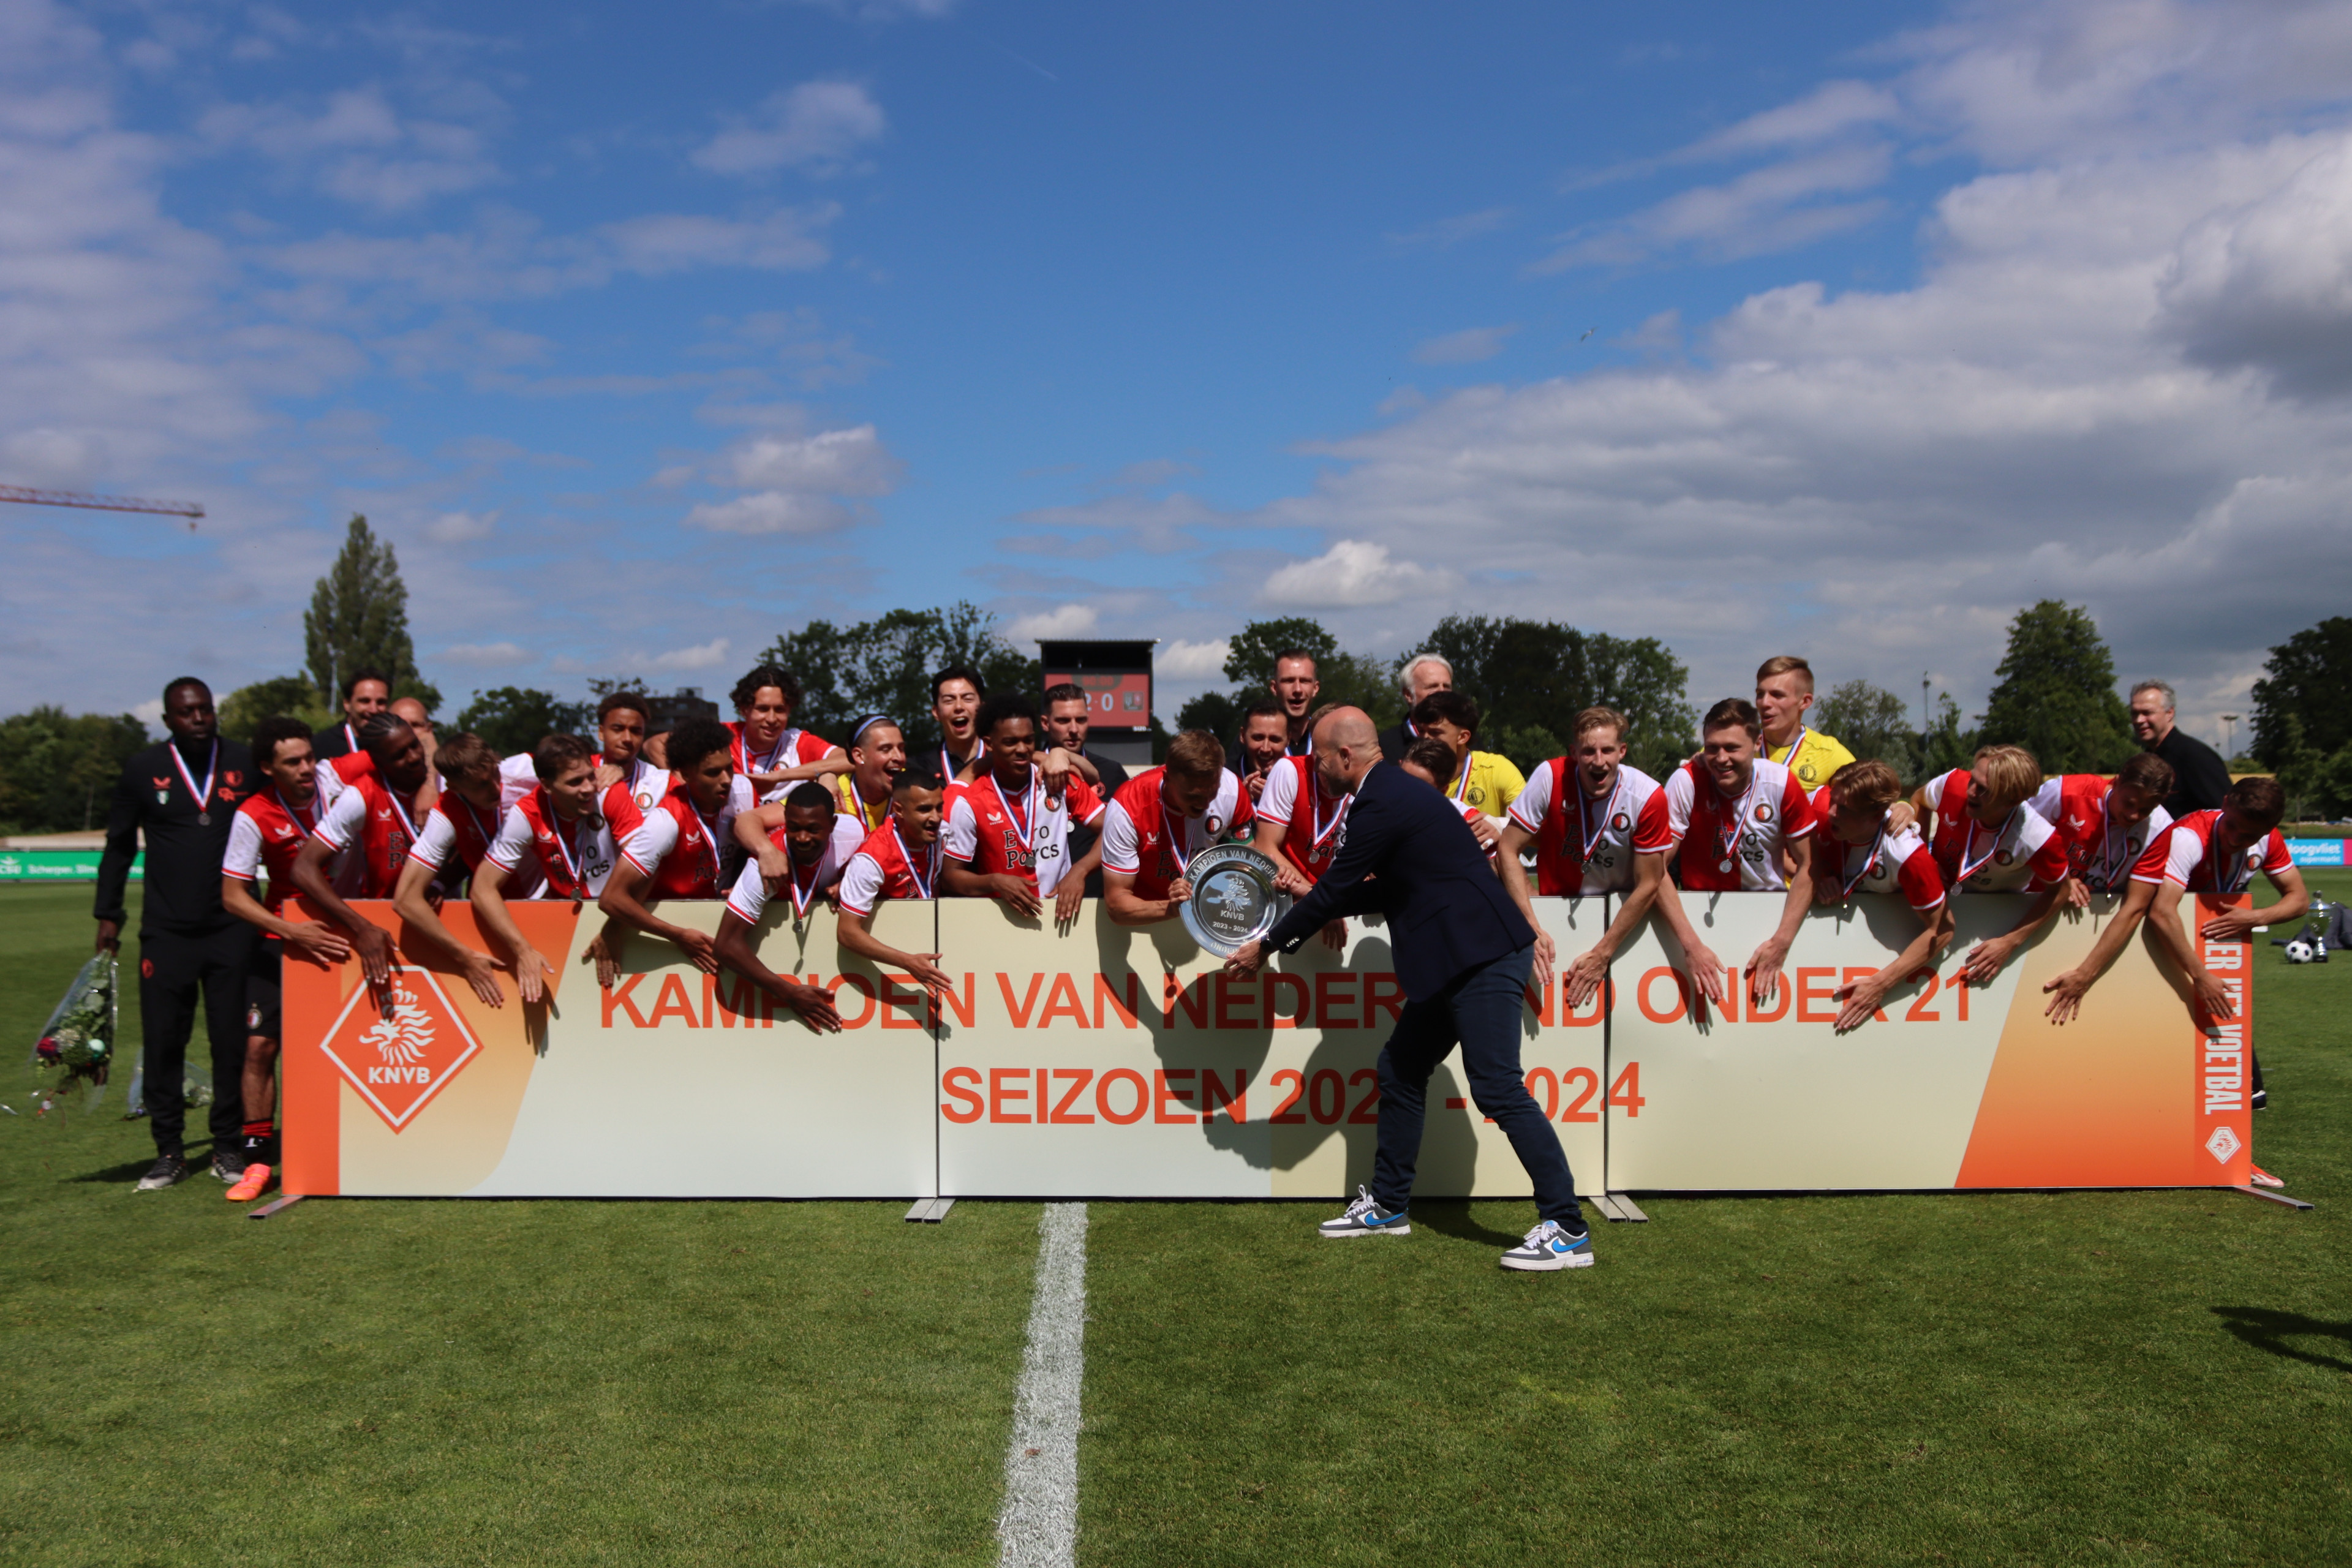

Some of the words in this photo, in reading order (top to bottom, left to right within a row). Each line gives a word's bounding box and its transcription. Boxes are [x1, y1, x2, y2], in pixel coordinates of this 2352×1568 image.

[1101, 693, 1114, 711] 0
[1003, 826, 1049, 850] Ero
[1564, 824, 1609, 850] Eo
[1189, 851, 1227, 881] KAMPIOEN
[1230, 850, 1246, 859] VAN
[1560, 843, 1614, 868] Pacs
[1711, 845, 1765, 863] Pcs
[554, 859, 610, 885] Prcs
[1213, 921, 1228, 930] 2023
[1220, 910, 1245, 921] KNVB
[2205, 933, 2243, 970] IER
[995, 972, 1138, 1029] VAN
[1163, 971, 1616, 1029] NEDERND
[1637, 966, 1889, 1023] ONDER
[1905, 966, 1969, 1021] 21
[368, 1066, 431, 1084] KNVB
[2205, 1023, 2243, 1115] VOETBAL
[940, 1066, 1246, 1125] SEIZOEN
[1268, 1068, 1379, 1125] 202
[1483, 1062, 1646, 1123] 024
